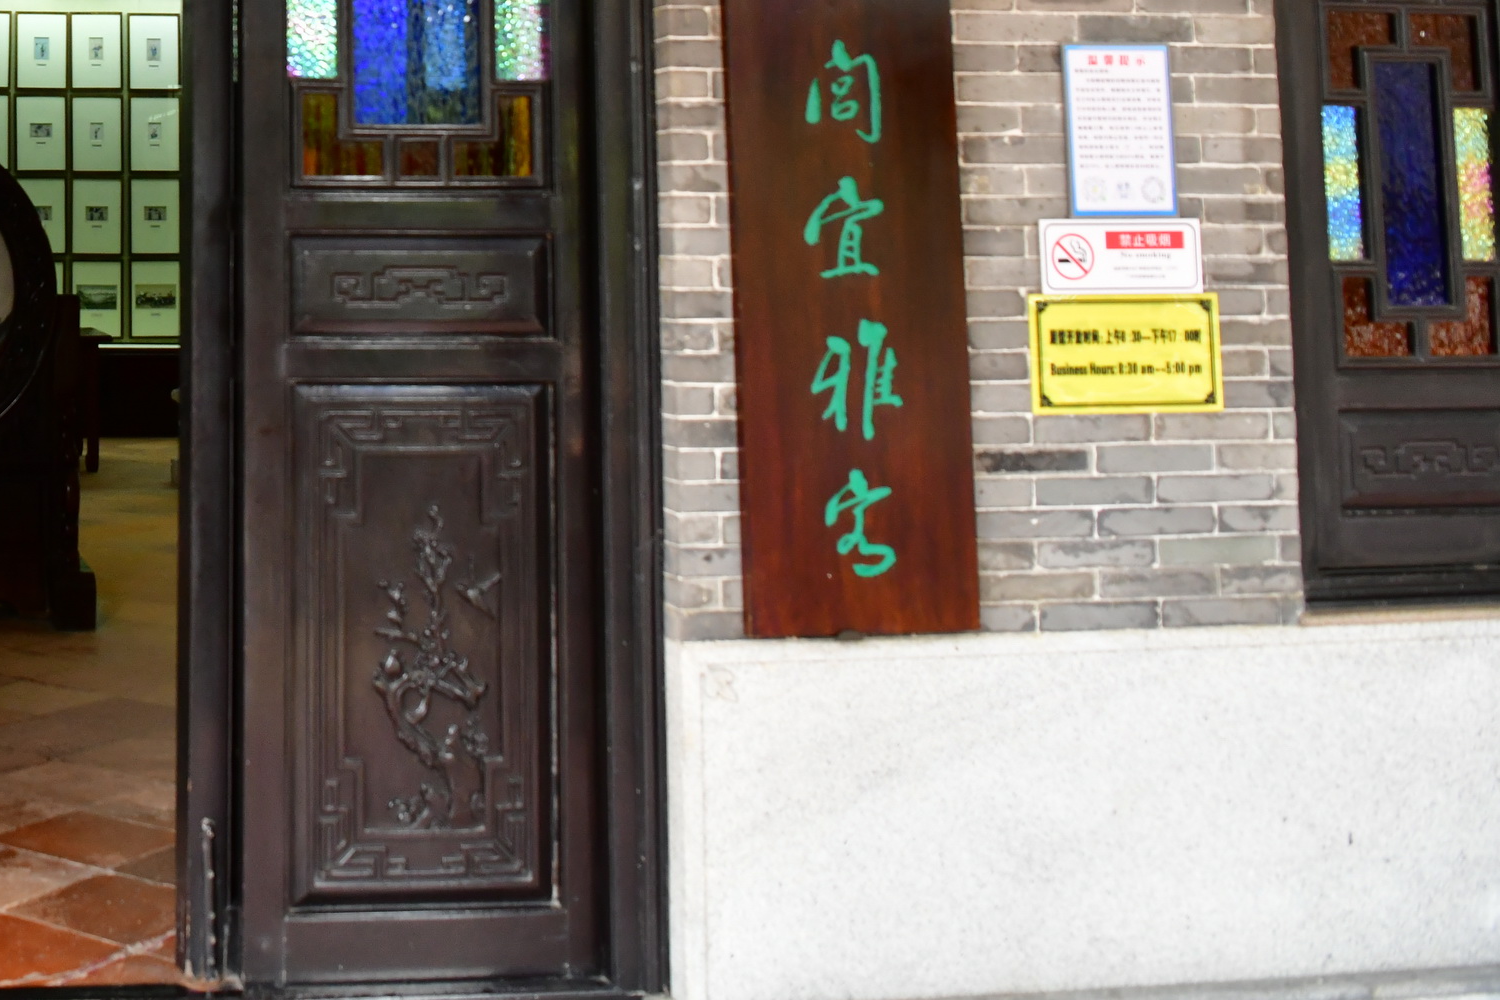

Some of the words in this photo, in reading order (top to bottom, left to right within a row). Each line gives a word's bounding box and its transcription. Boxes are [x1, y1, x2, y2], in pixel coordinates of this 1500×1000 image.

[1118, 232, 1171, 248] 禁止吸烟
[1051, 363, 1087, 375] Business
